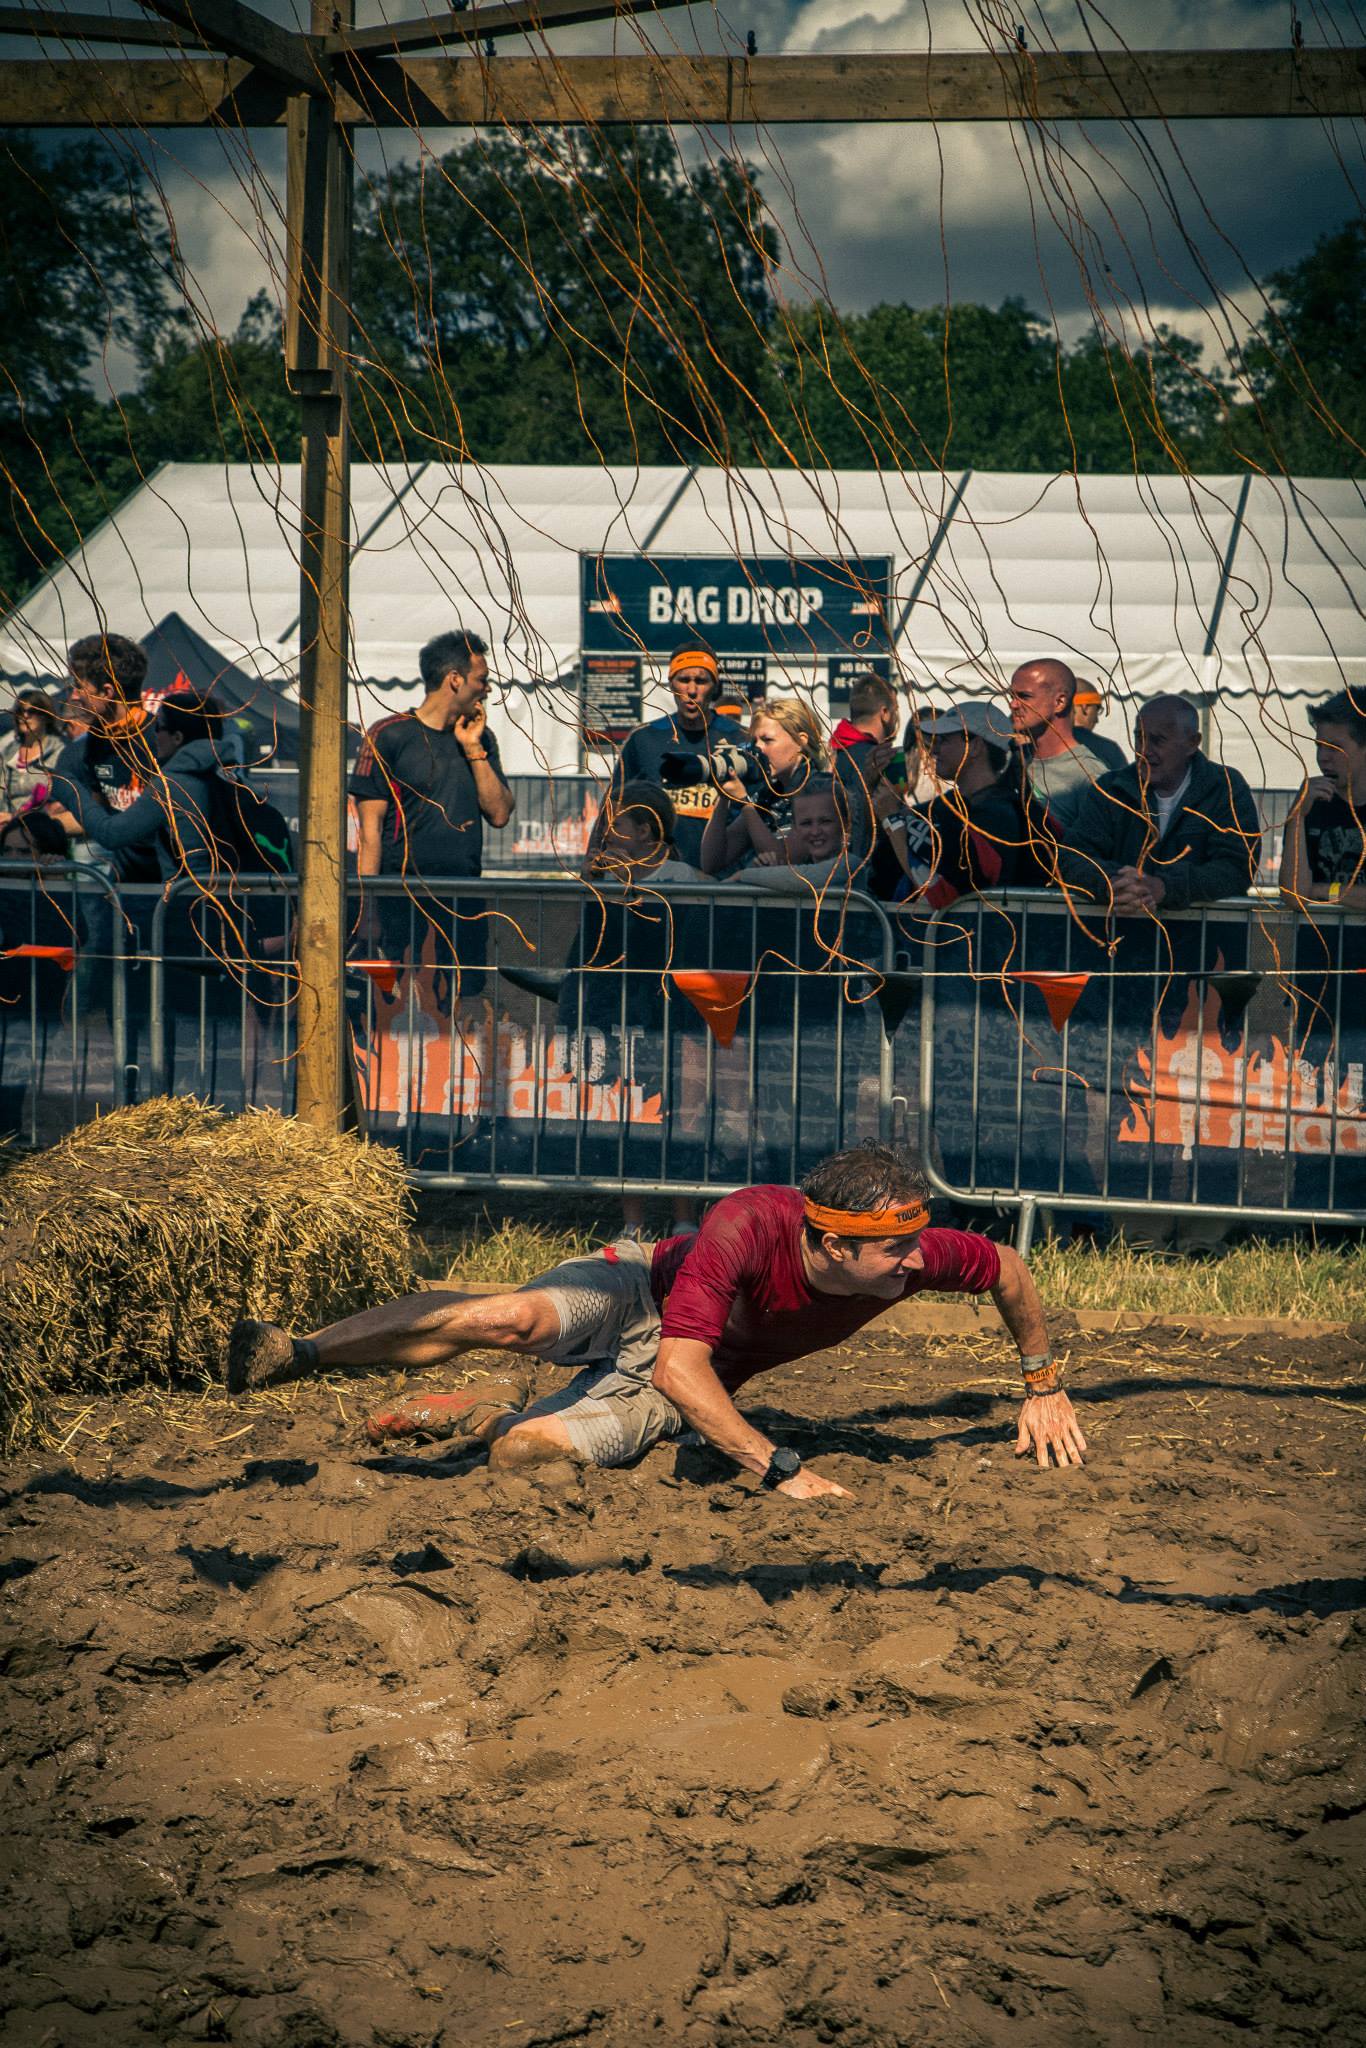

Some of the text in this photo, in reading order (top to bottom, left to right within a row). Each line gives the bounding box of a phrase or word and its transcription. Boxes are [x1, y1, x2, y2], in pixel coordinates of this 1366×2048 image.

[648, 586, 824, 625] BAG DROP
[895, 1207, 922, 1223] TOUGH
